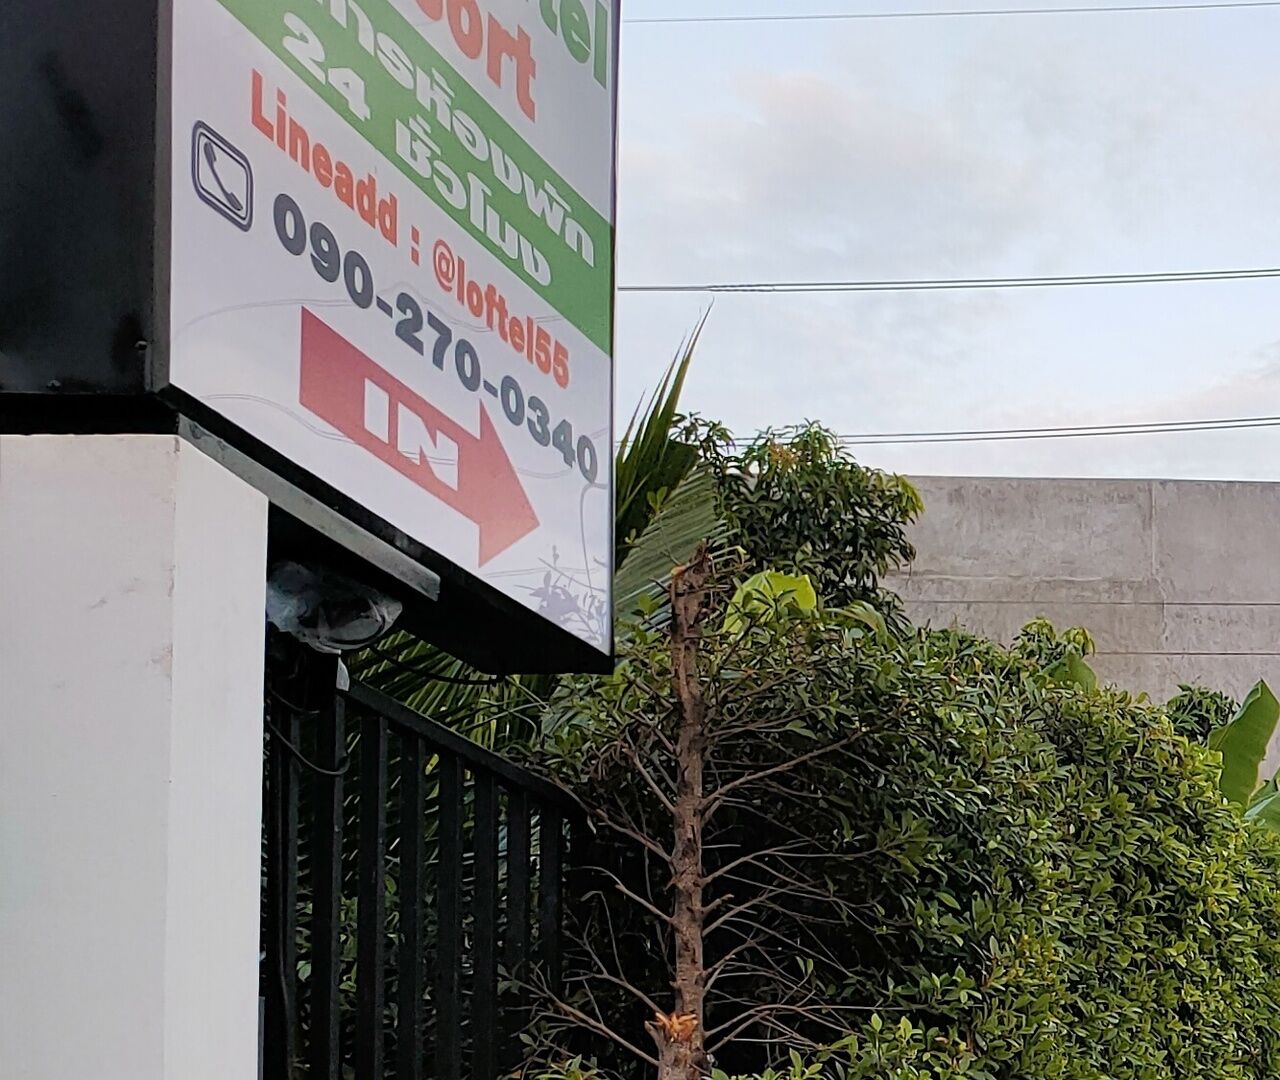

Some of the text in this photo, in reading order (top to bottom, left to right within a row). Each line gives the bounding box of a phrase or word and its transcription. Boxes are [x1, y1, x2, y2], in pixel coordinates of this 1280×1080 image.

[251, 68, 397, 248] Lineadd
[433, 239, 570, 389] @loftel55
[282, 11, 551, 286] 24 ชั่วโมง
[273, 193, 597, 484] 090-270-0340
[364, 378, 458, 491] IN
